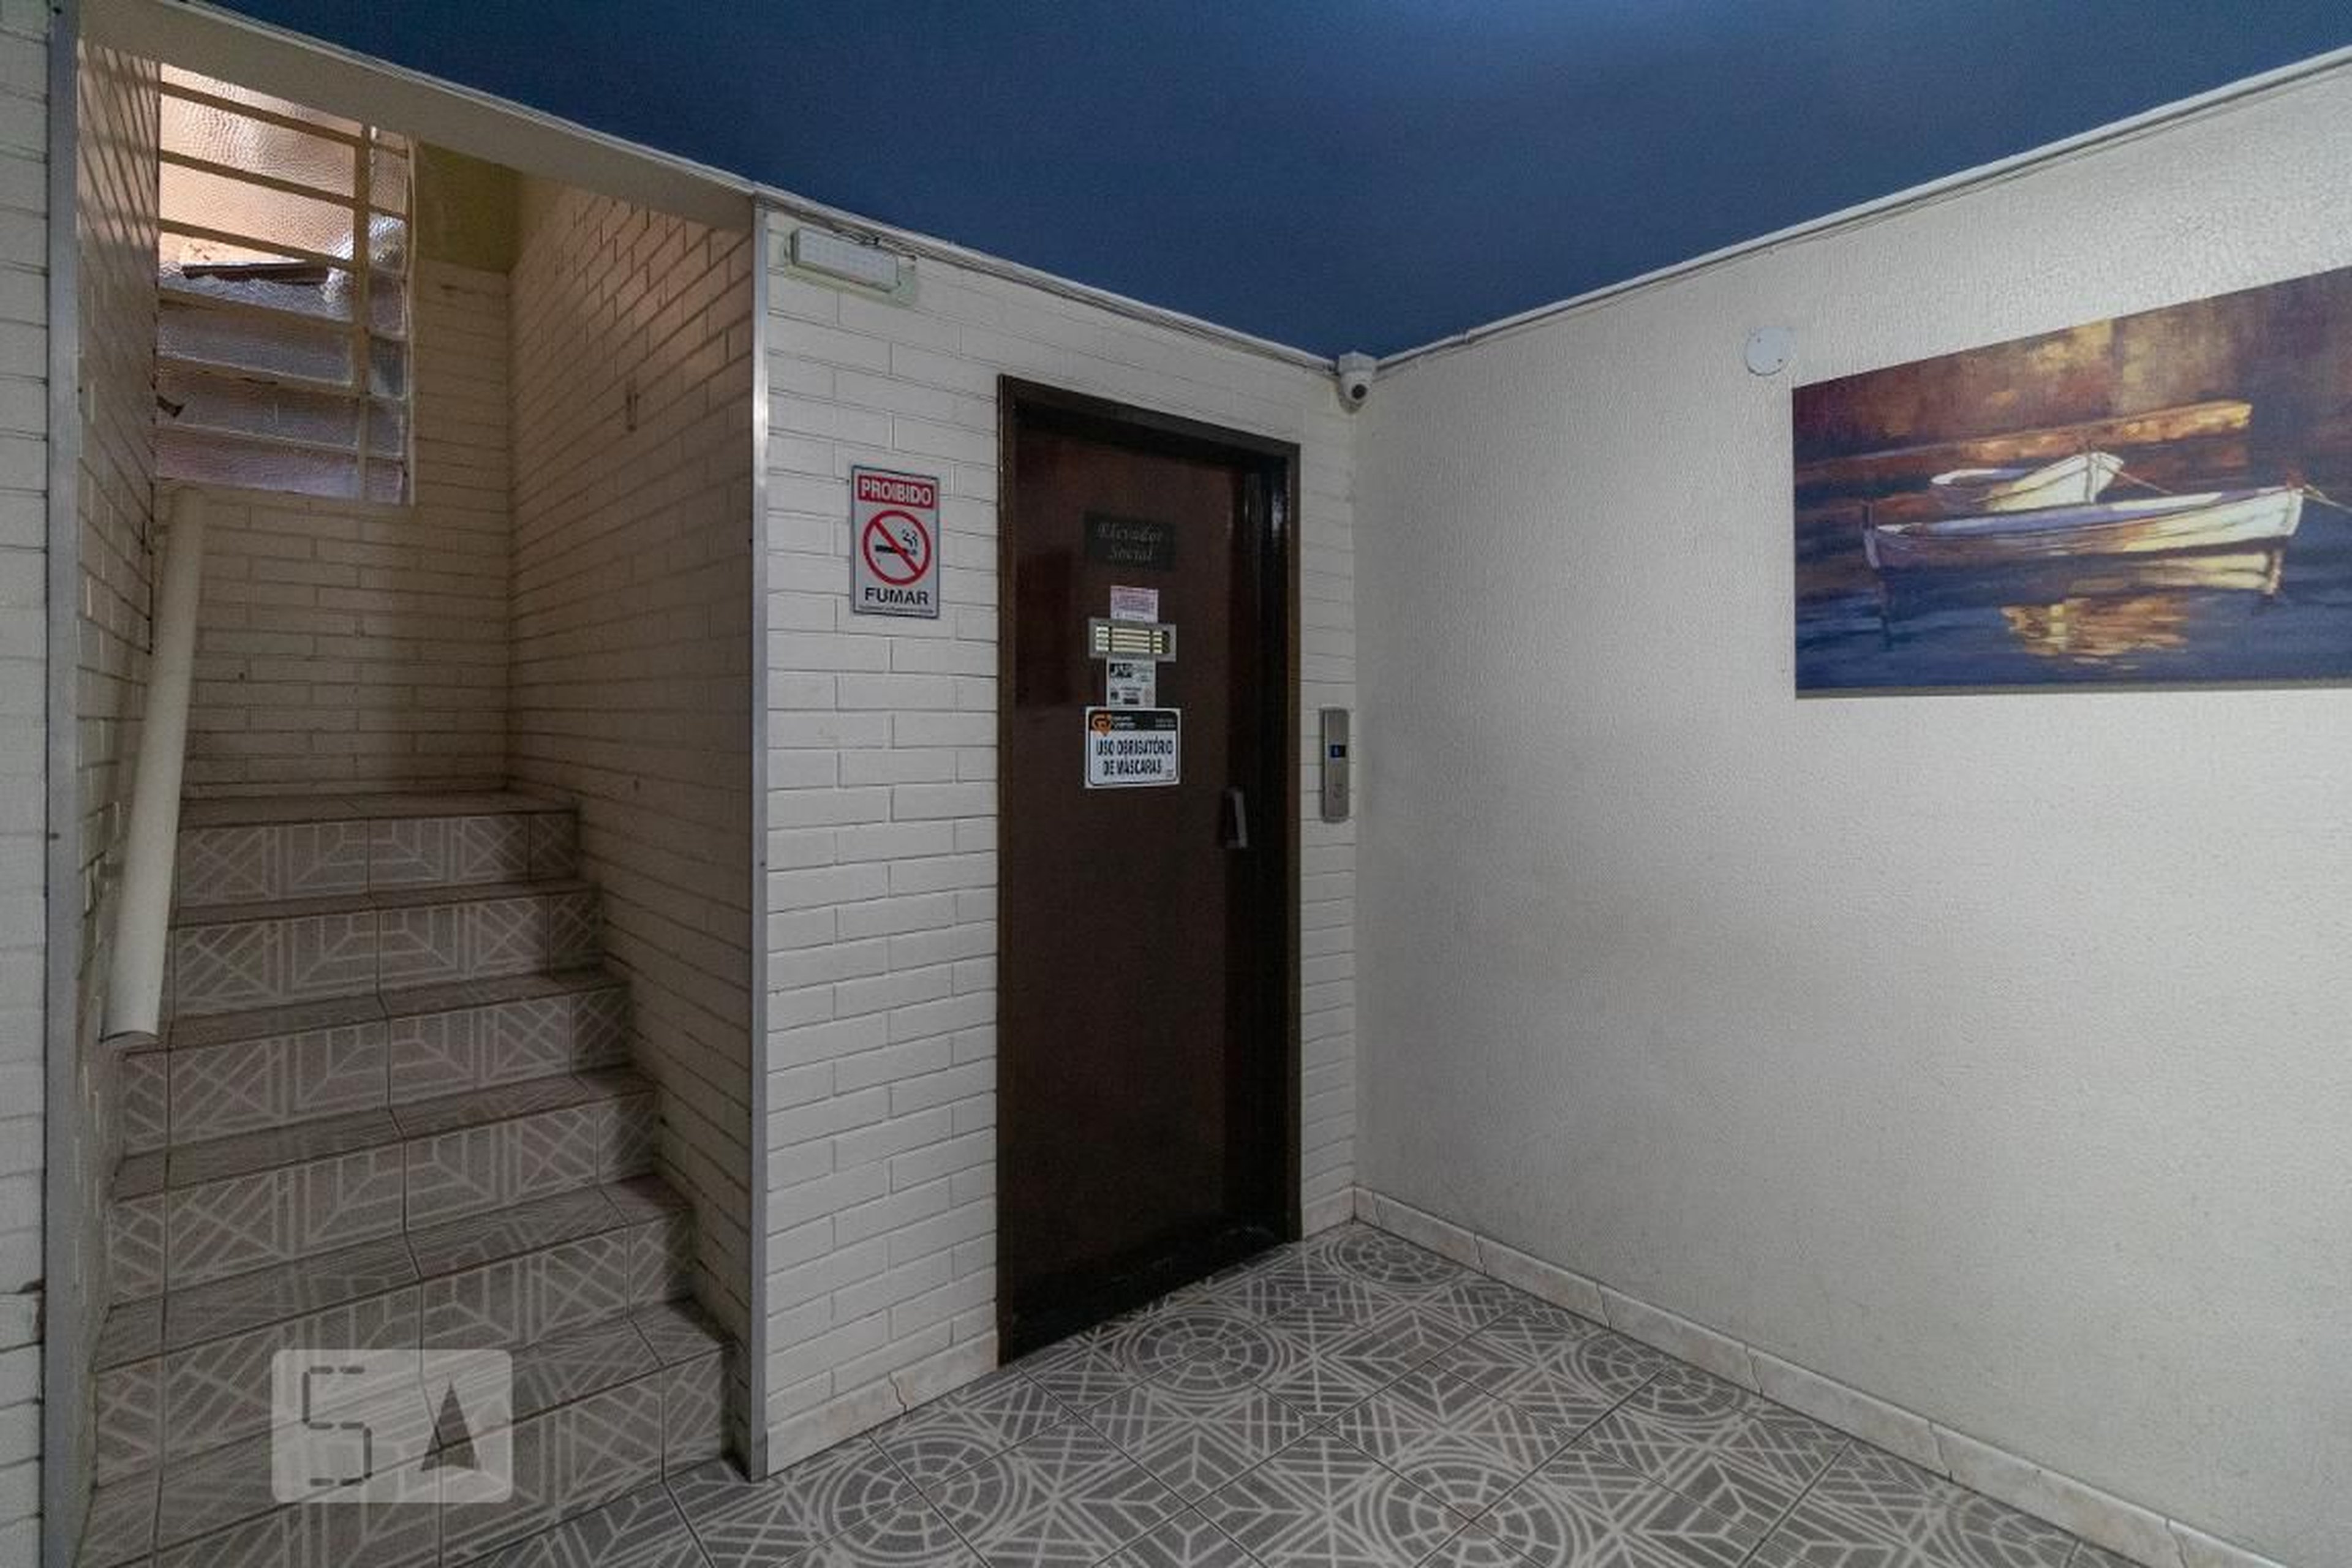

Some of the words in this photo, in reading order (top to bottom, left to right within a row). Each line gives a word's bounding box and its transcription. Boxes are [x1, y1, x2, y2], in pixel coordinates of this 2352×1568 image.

[861, 478, 932, 505] PROIBIDO
[865, 587, 929, 605] FUMAR
[1096, 739, 1115, 756] USO
[1117, 736, 1173, 756] OBRIGATÓRIO
[1103, 760, 1115, 776] DE
